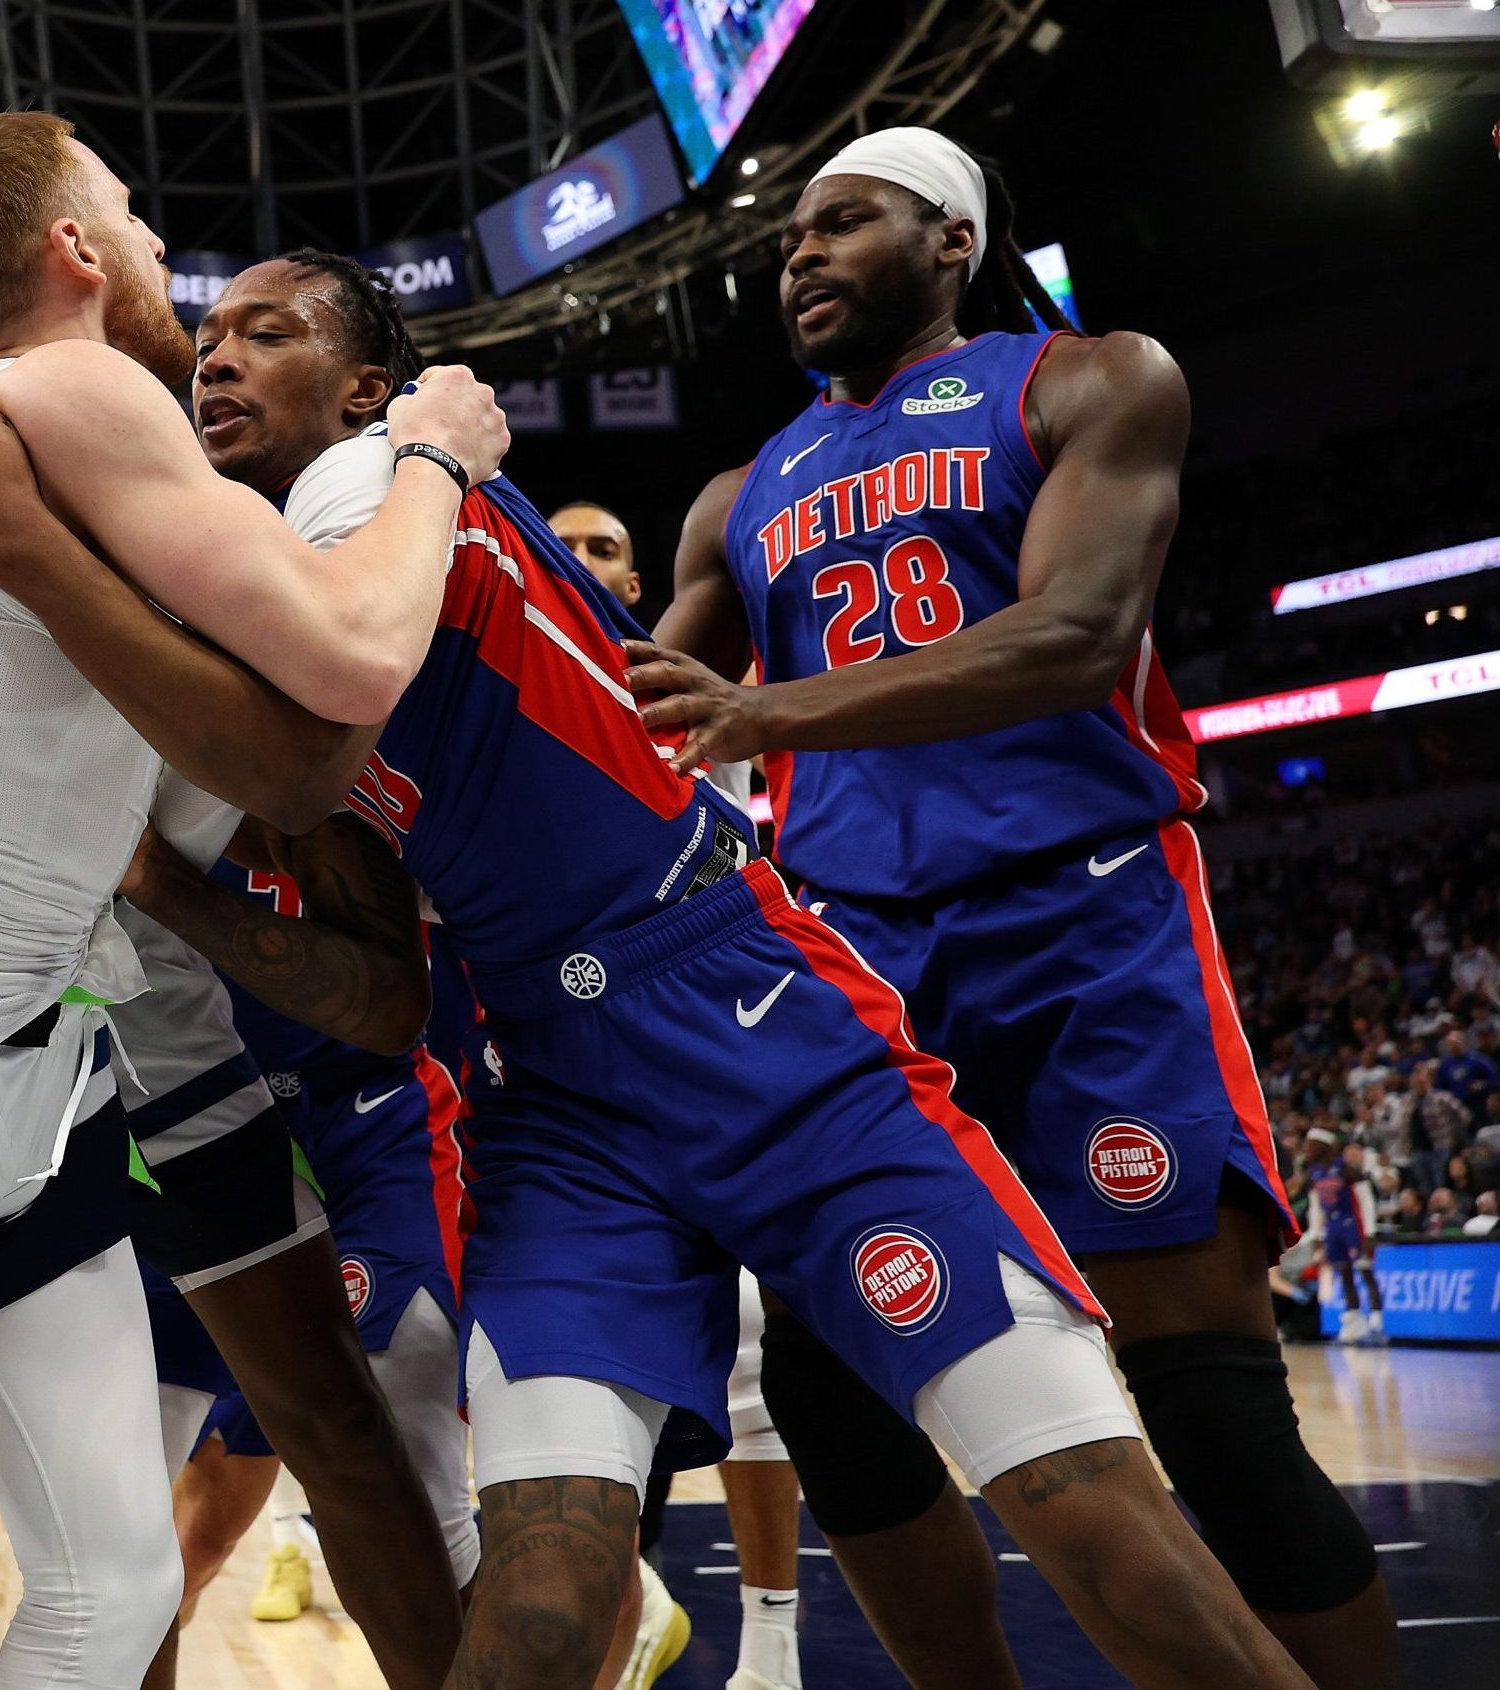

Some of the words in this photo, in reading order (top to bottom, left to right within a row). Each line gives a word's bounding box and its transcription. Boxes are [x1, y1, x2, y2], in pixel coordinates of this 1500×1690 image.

[905, 397, 978, 412] StockX
[413, 444, 459, 474] Blessed
[757, 447, 990, 585] DETROIT
[812, 535, 964, 671] 28
[654, 859, 685, 902] DETROIT
[678, 805, 707, 864] BASKETBALL
[1096, 1146, 1153, 1164] DETROIT
[1098, 1160, 1157, 1179] PISTONS
[863, 1248, 918, 1293] DETROIT
[873, 1262, 929, 1309] PISTONS
